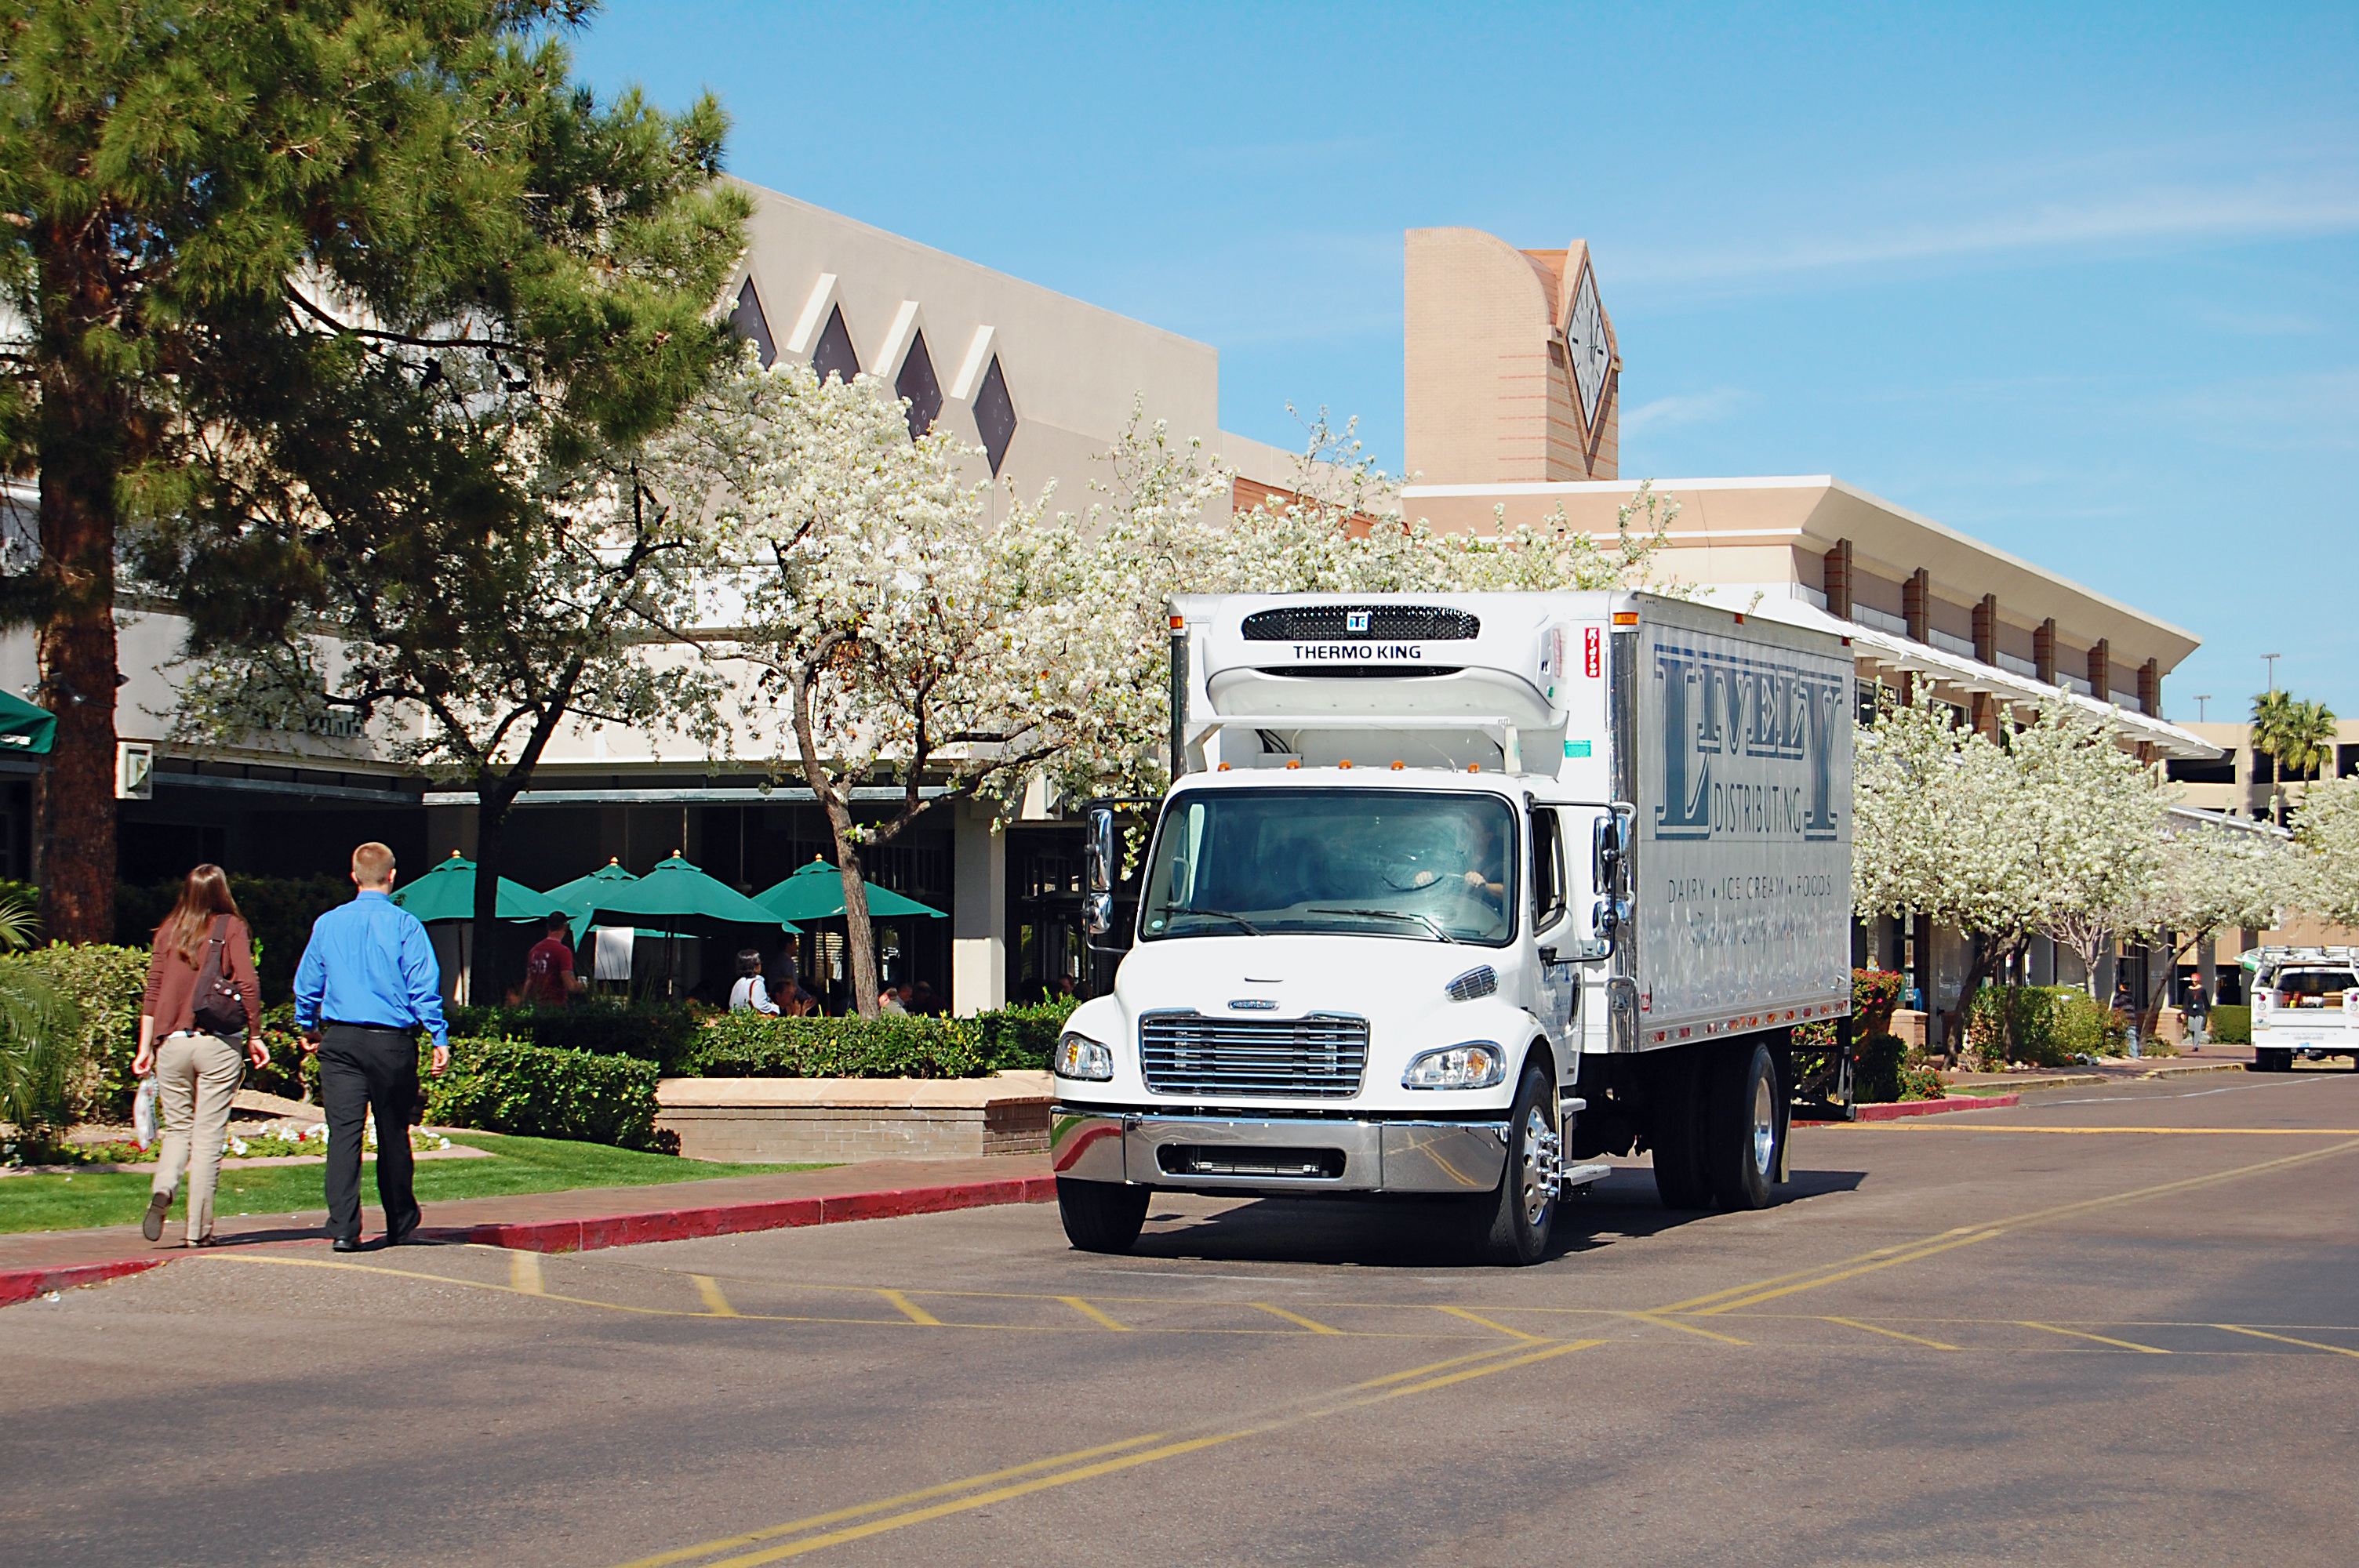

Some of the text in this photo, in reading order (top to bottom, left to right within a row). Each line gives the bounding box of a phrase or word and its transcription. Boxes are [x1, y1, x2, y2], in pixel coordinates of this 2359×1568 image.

[1293, 645, 1421, 659] THERMO KING
[1587, 628, 1598, 677] Kidron
[1714, 782, 1801, 833] DISTRIBUTING
[1668, 874, 1830, 903] DAIRY ICE CREAM FOODS
